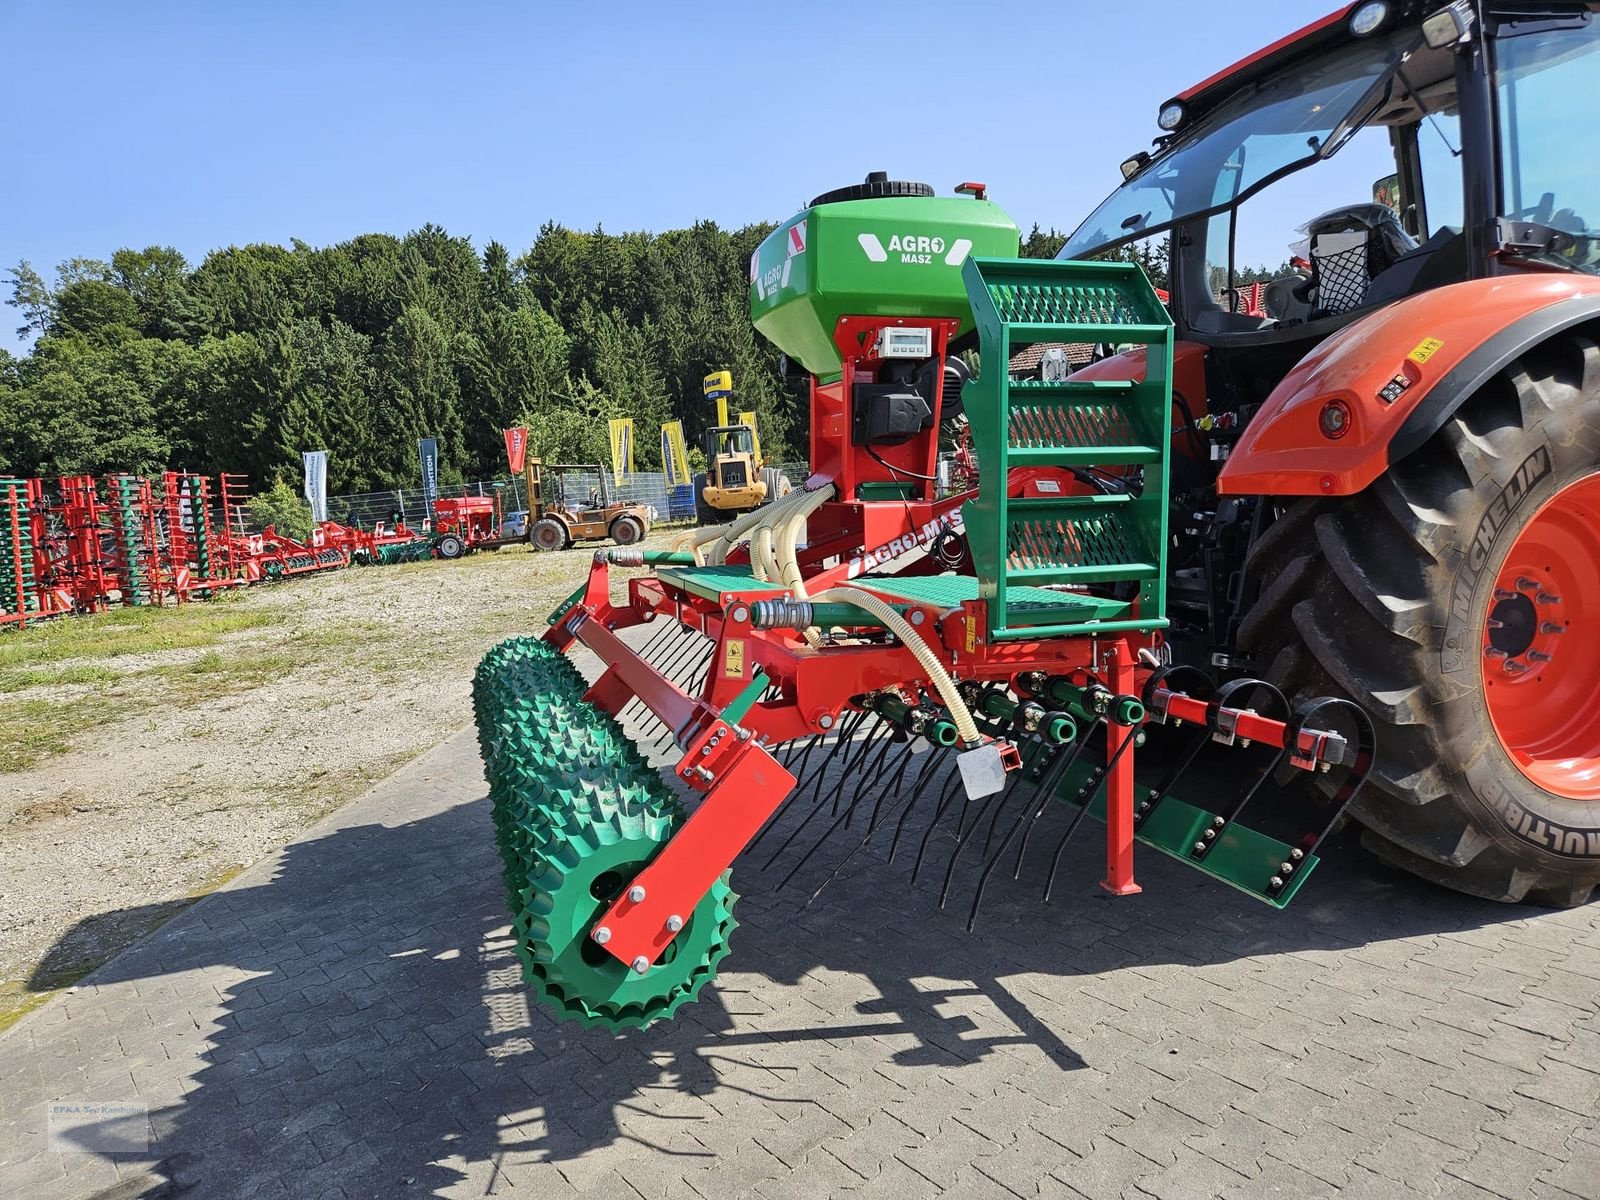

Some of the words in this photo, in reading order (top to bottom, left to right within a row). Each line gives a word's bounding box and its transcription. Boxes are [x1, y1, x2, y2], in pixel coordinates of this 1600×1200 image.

[888, 235, 945, 253] AGRO
[901, 253, 932, 264] MASZ
[764, 264, 782, 288] AGRO
[426, 455, 436, 497] FARMTECH
[863, 506, 964, 572] AGRO-MAS
[1452, 449, 1546, 620] MICHELIN
